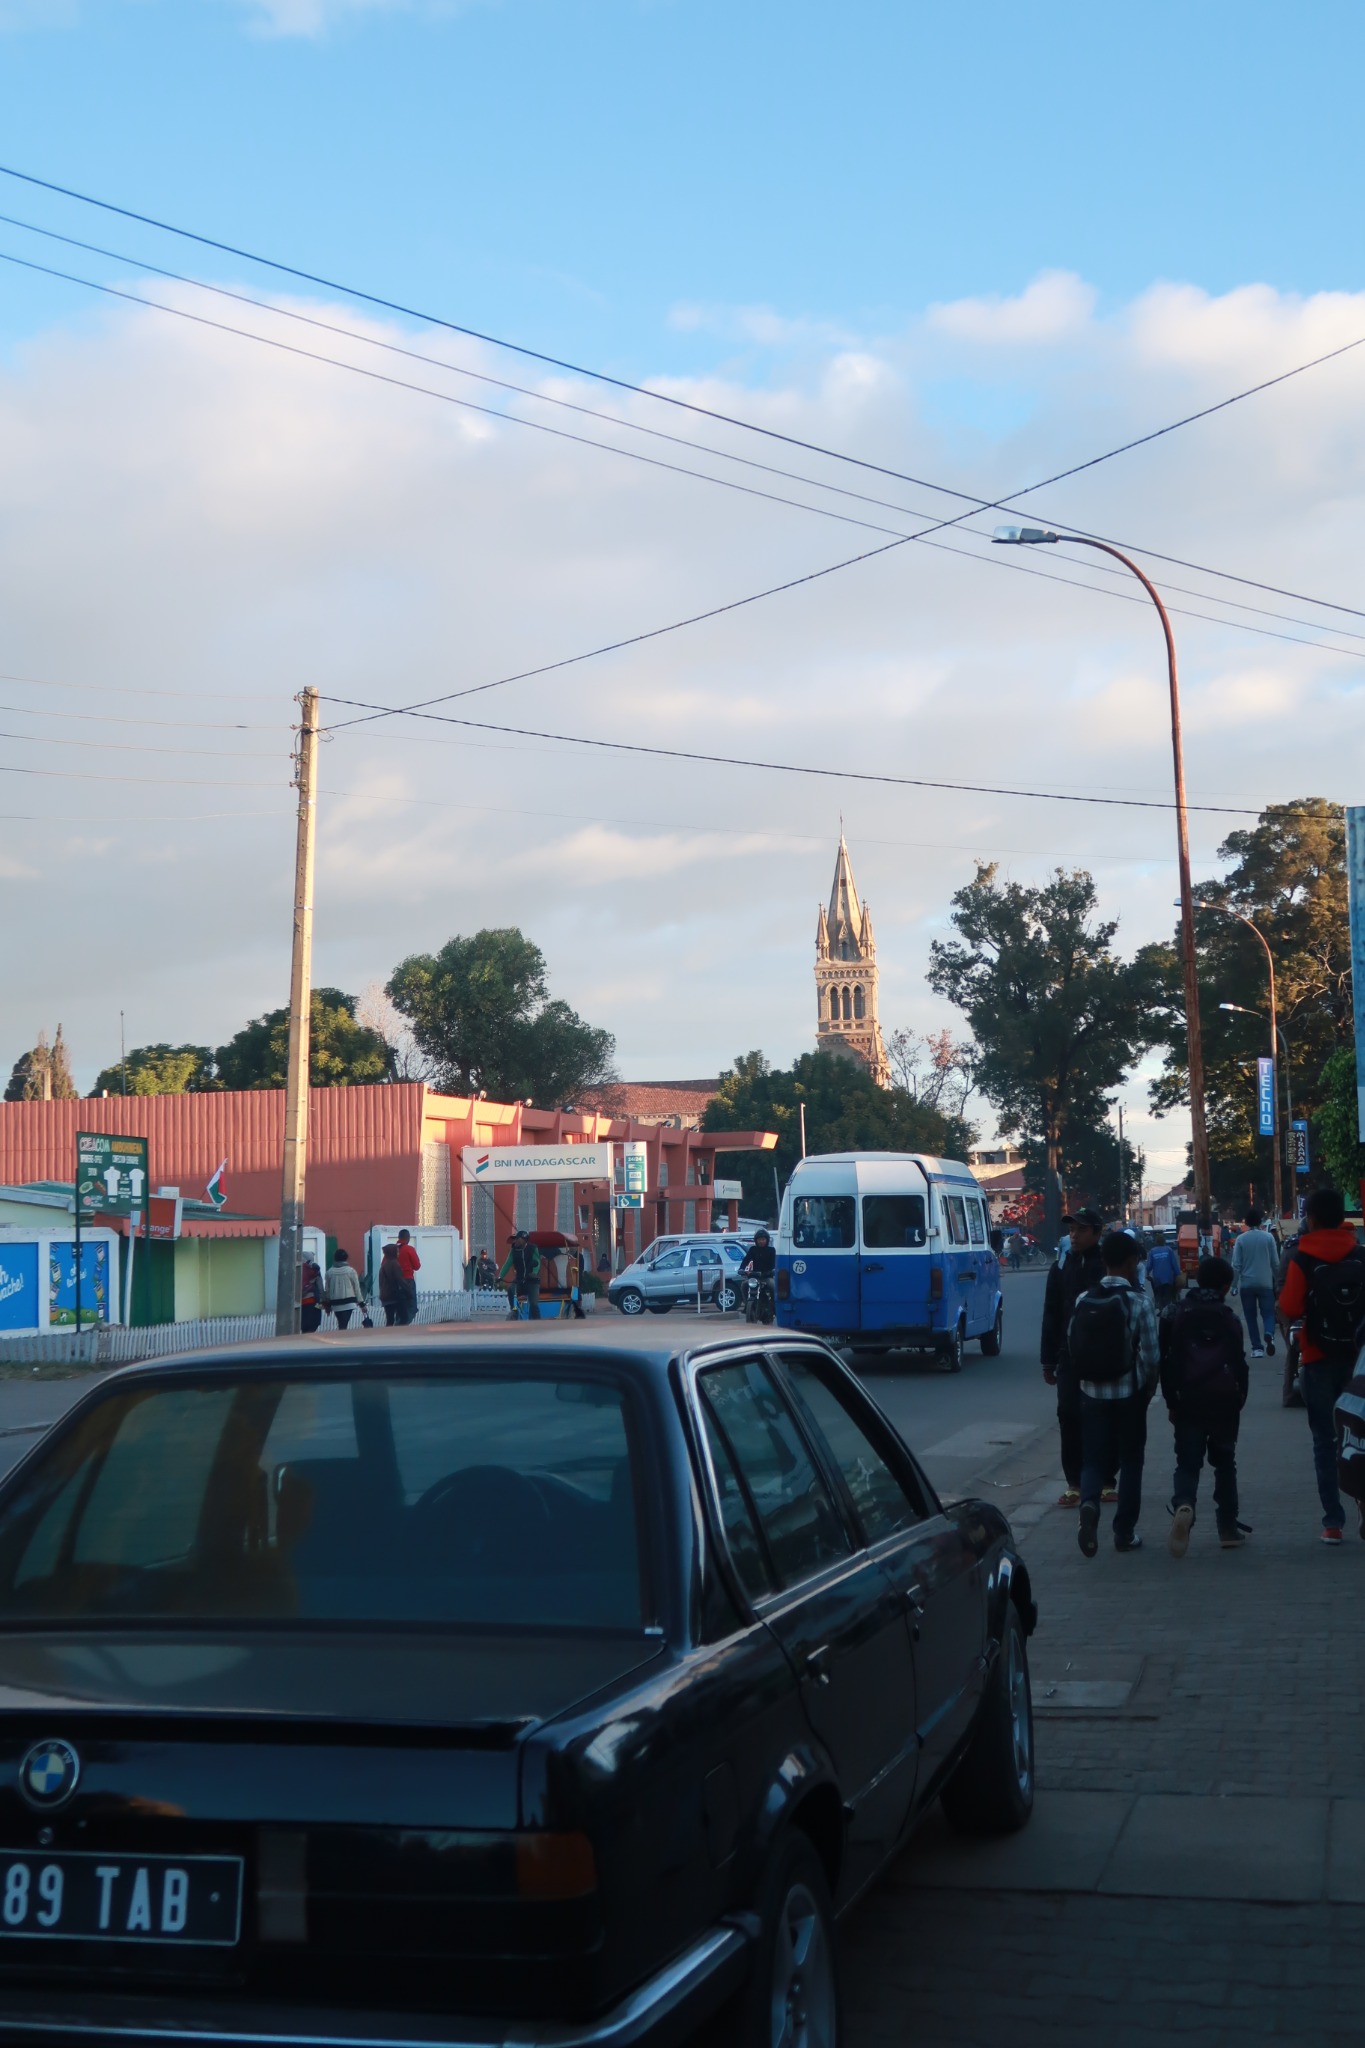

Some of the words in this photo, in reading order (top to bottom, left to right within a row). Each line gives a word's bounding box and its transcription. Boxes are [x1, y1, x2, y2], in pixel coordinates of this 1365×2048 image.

[494, 1159, 511, 1168] BNI
[514, 1157, 596, 1167] MADAGASCAR
[141, 1224, 170, 1235] oange
[795, 1262, 804, 1272] 75
[0, 1272, 24, 1302] ache!
[2, 1863, 65, 1927] 89
[95, 1866, 189, 1933] TAB
